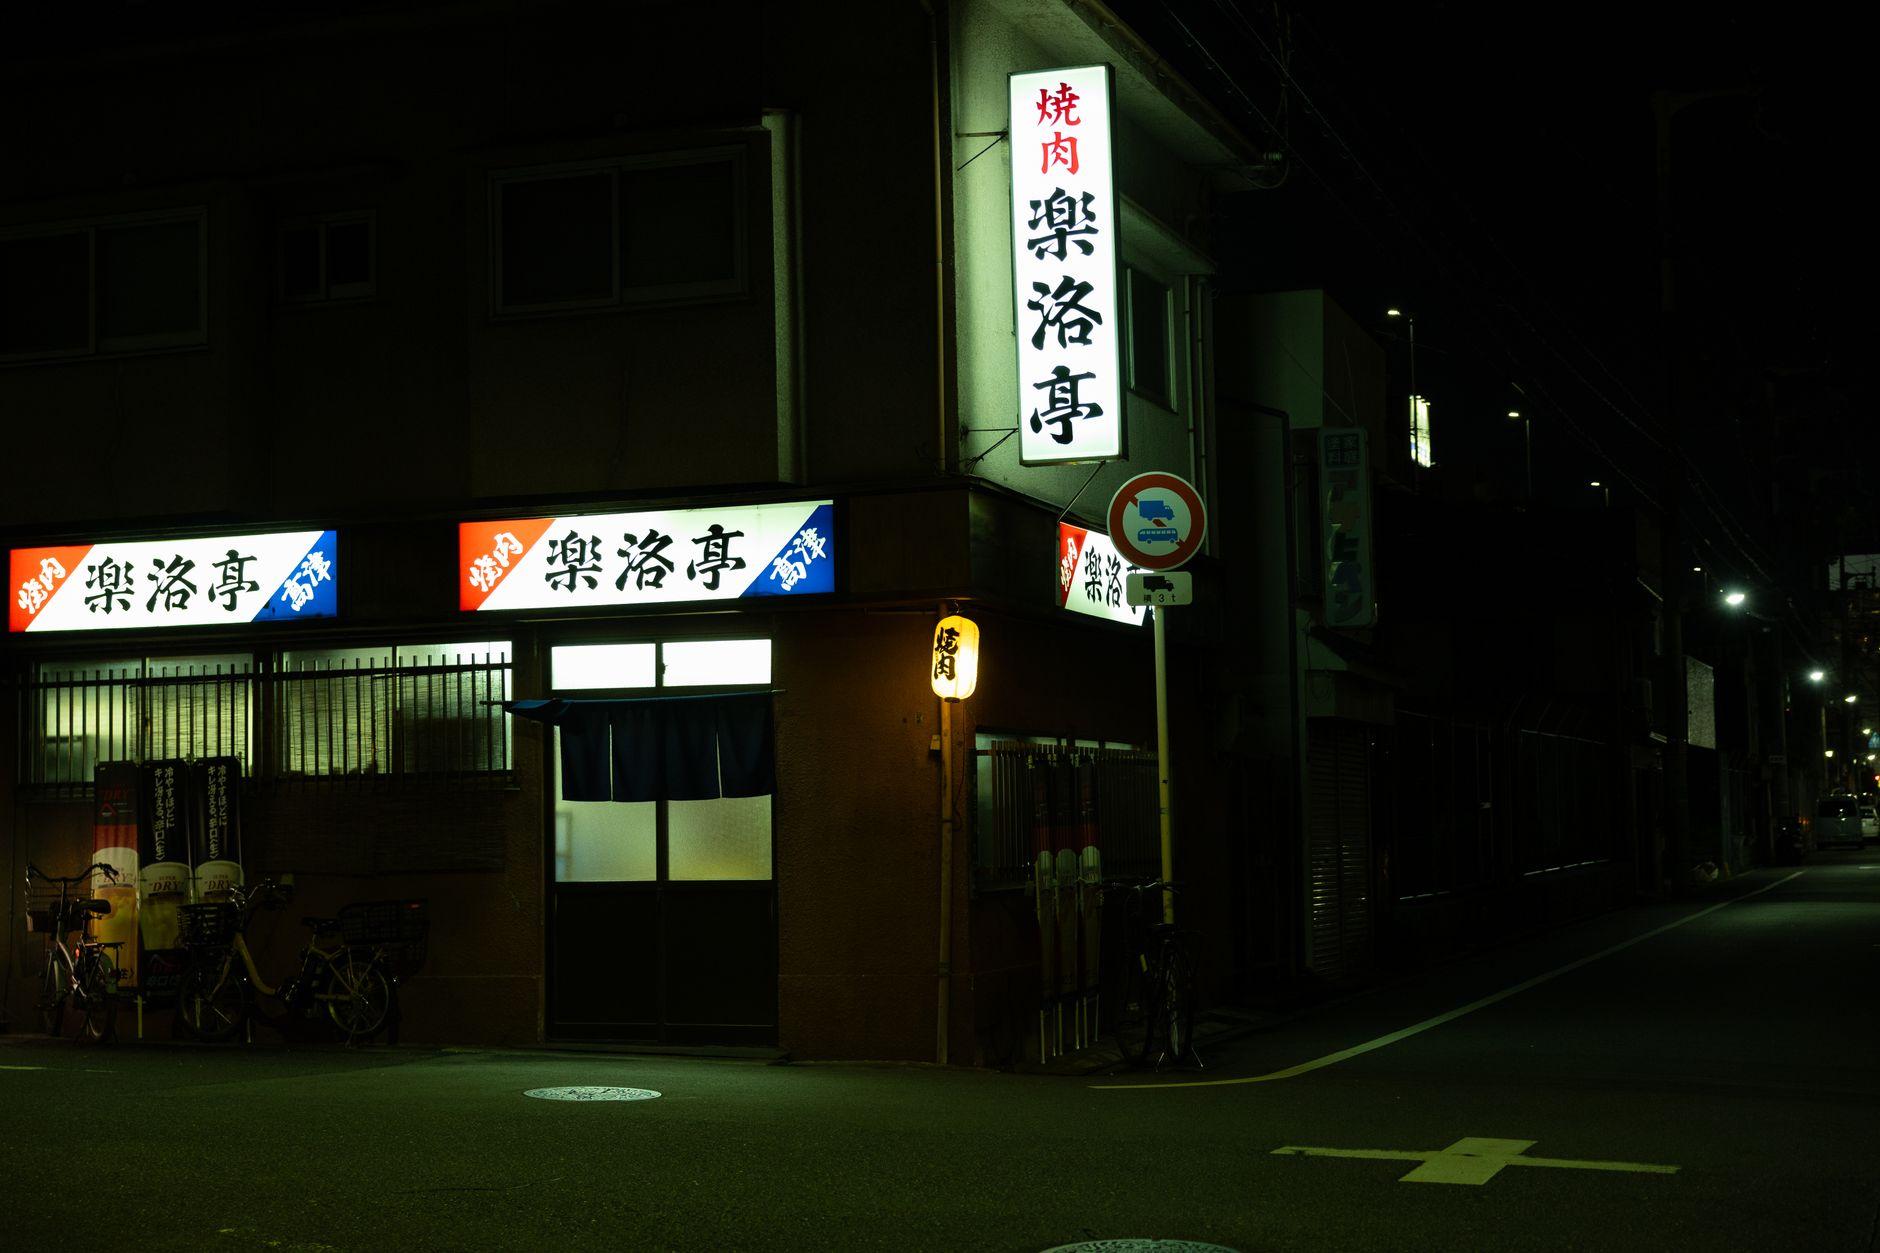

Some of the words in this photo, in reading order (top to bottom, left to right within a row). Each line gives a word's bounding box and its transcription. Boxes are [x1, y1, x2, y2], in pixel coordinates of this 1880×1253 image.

[1036, 82, 1080, 175] 焼肉
[1027, 186, 1104, 445] 楽洛亭
[18, 557, 66, 615] 焼肉
[84, 549, 260, 616] 楽洛亭
[468, 531, 523, 592] 焼肉
[544, 523, 747, 593] 楽洛亭
[1060, 536, 1078, 593] 焼肉
[1084, 545, 1141, 615] 楽洛
[934, 626, 960, 681] 焼肉
